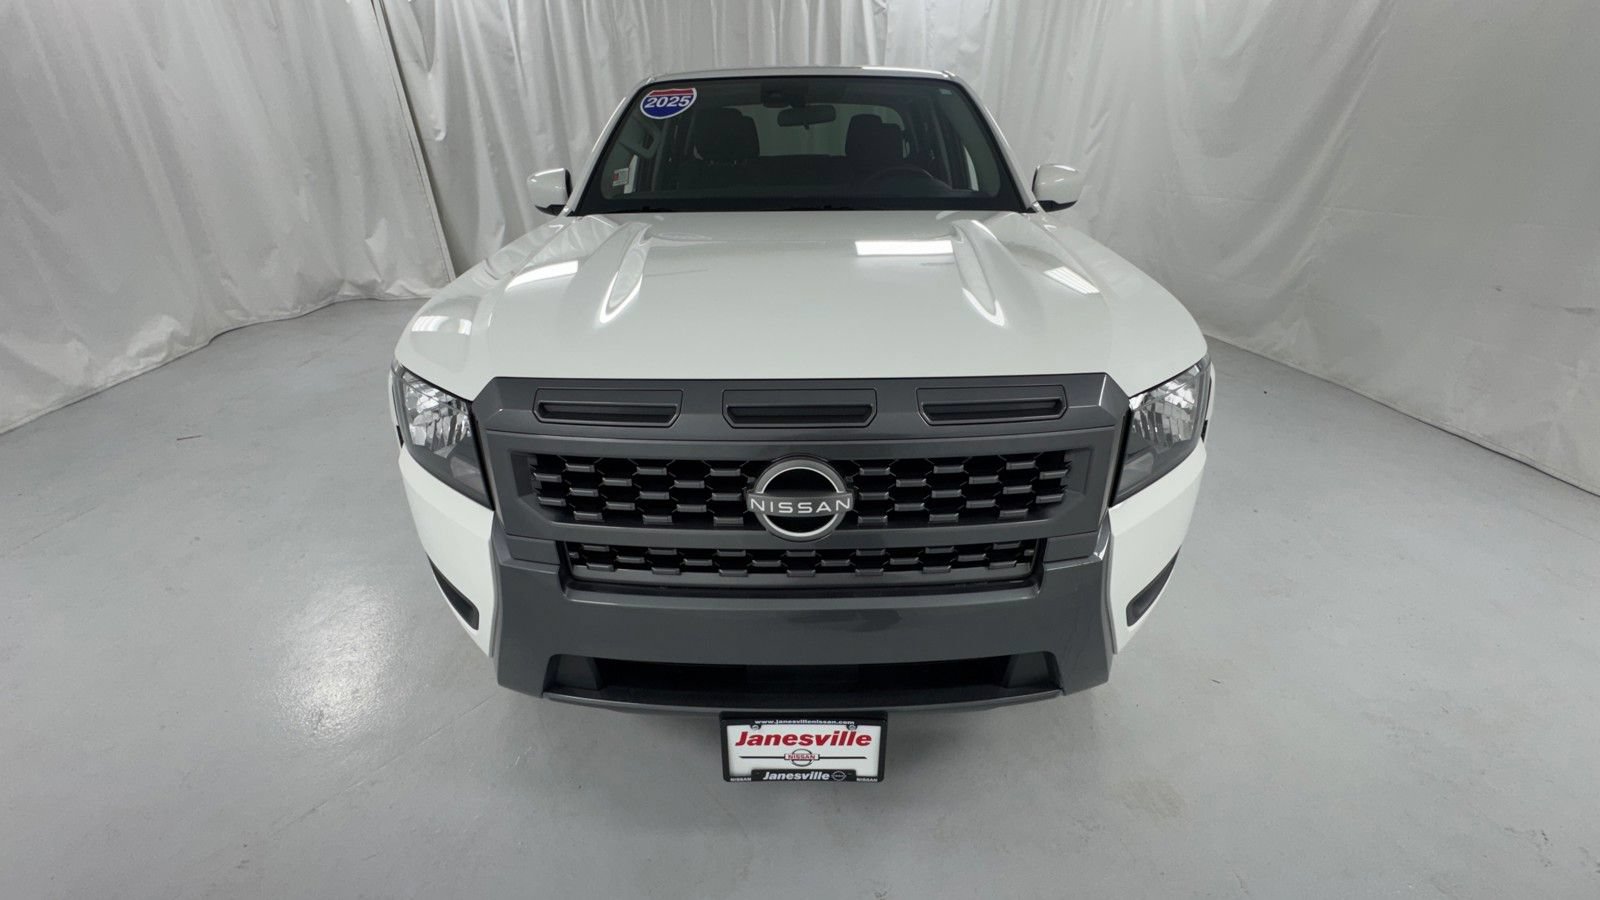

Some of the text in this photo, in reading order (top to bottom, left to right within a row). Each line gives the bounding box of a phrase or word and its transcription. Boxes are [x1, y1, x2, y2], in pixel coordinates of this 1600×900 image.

[644, 96, 692, 108] 2025
[750, 498, 850, 514] NISSAN
[735, 731, 872, 747] Janesville
[762, 771, 830, 781] Janesville
